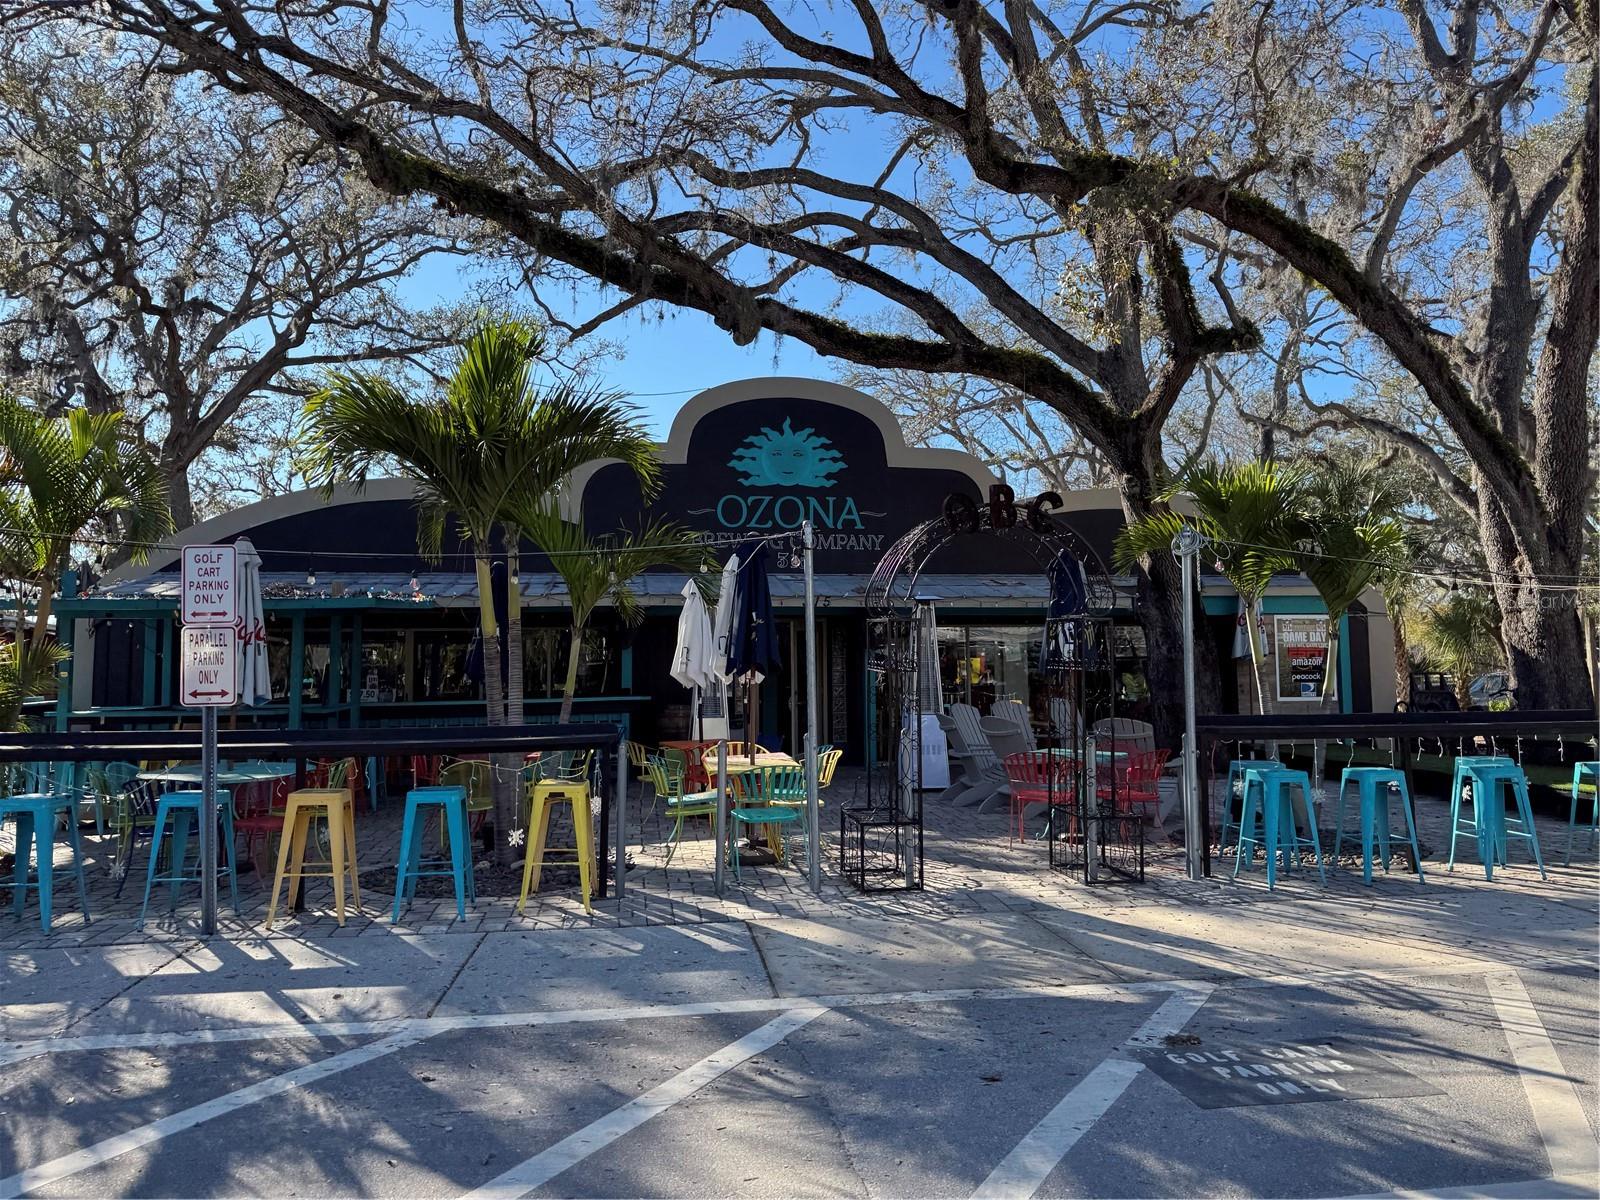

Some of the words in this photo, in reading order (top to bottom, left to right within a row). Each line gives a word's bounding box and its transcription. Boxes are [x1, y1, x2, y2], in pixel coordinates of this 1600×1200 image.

[716, 494, 865, 530] OZONA
[943, 484, 1064, 534] OBC
[194, 554, 223, 563] GOLF
[197, 567, 221, 577] CART
[188, 580, 229, 591] PARKING
[194, 594, 224, 604] ONLY
[189, 634, 228, 647] PARALLEL
[1283, 631, 1308, 643] GAME
[1309, 631, 1327, 643] DAY
[193, 652, 224, 665] PARKING
[1291, 657, 1322, 666] amazon
[198, 669, 219, 684] ONLY
[1291, 673, 1321, 682] peacock
[1165, 1050, 1242, 1065] GOLF
[1259, 1044, 1342, 1060] CART
[1211, 1059, 1354, 1079] PARKING
[1255, 1078, 1347, 1096] ONLY
